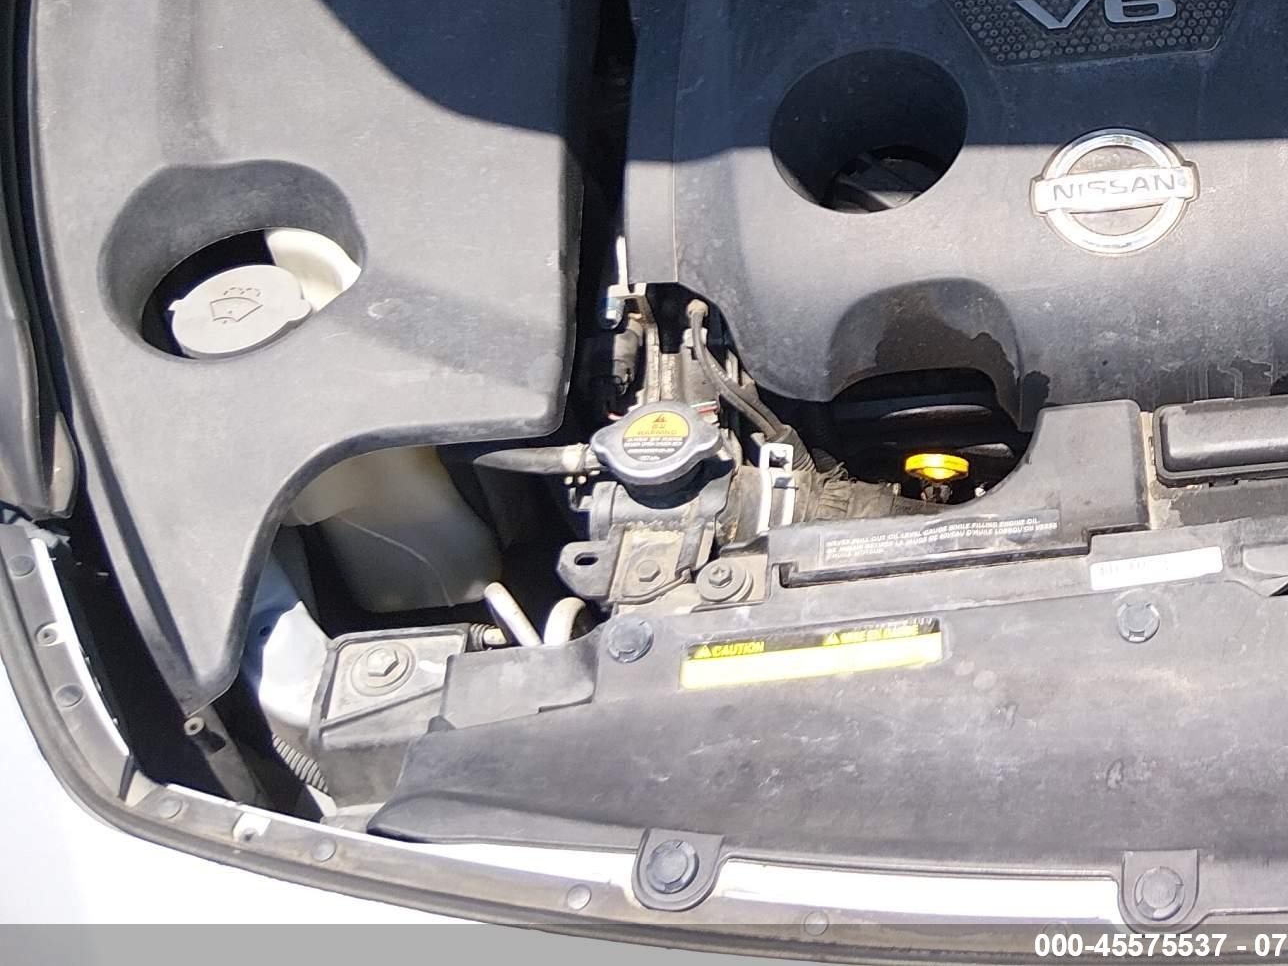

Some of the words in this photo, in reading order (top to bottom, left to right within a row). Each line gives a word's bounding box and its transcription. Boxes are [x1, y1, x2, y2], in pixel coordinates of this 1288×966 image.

[1053, 172, 1176, 201] NISSAN
[872, 534, 886, 542] OUT
[712, 641, 765, 657] CAUTION
